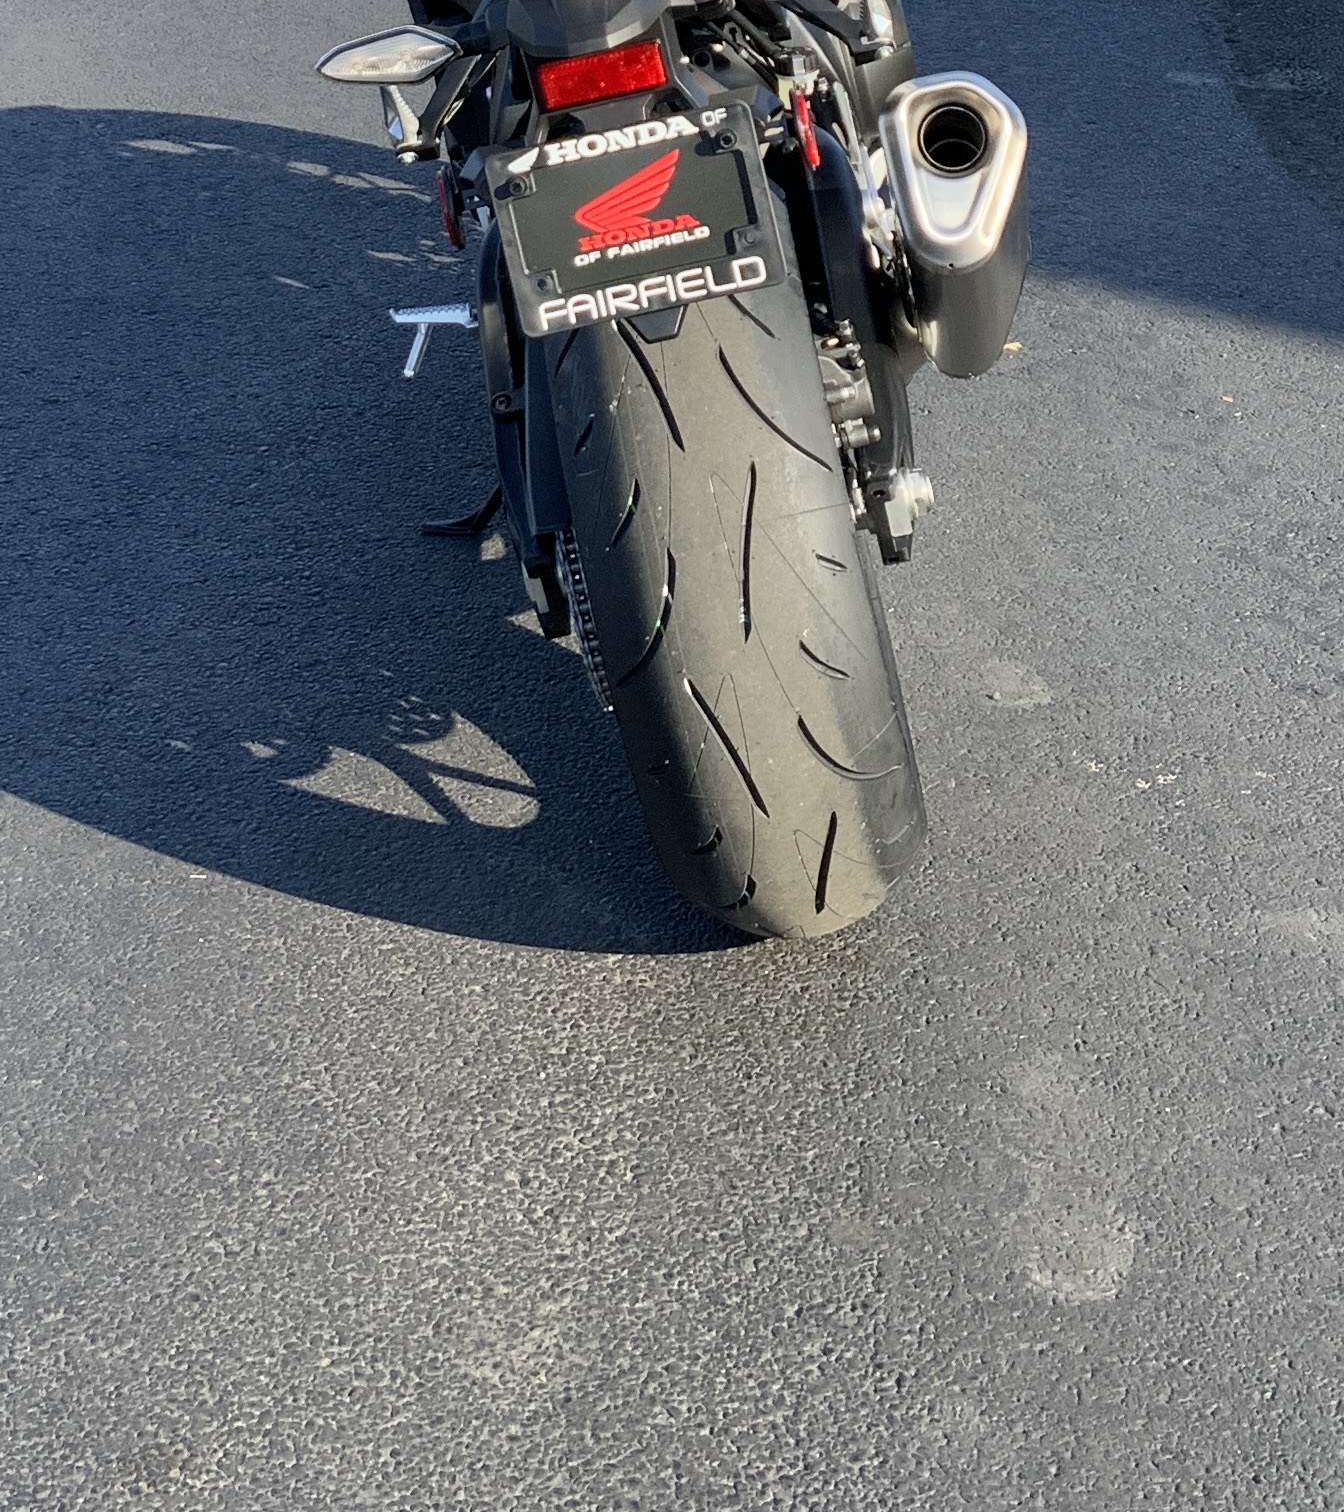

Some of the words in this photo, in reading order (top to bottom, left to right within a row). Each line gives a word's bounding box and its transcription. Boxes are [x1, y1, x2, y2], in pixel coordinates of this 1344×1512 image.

[544, 115, 700, 166] HONDA
[701, 107, 728, 128] OF
[574, 251, 602, 268] OF
[607, 226, 710, 261] FAIRFIELD
[578, 214, 700, 251] HONDA
[538, 256, 768, 332] FAIRFIELD
